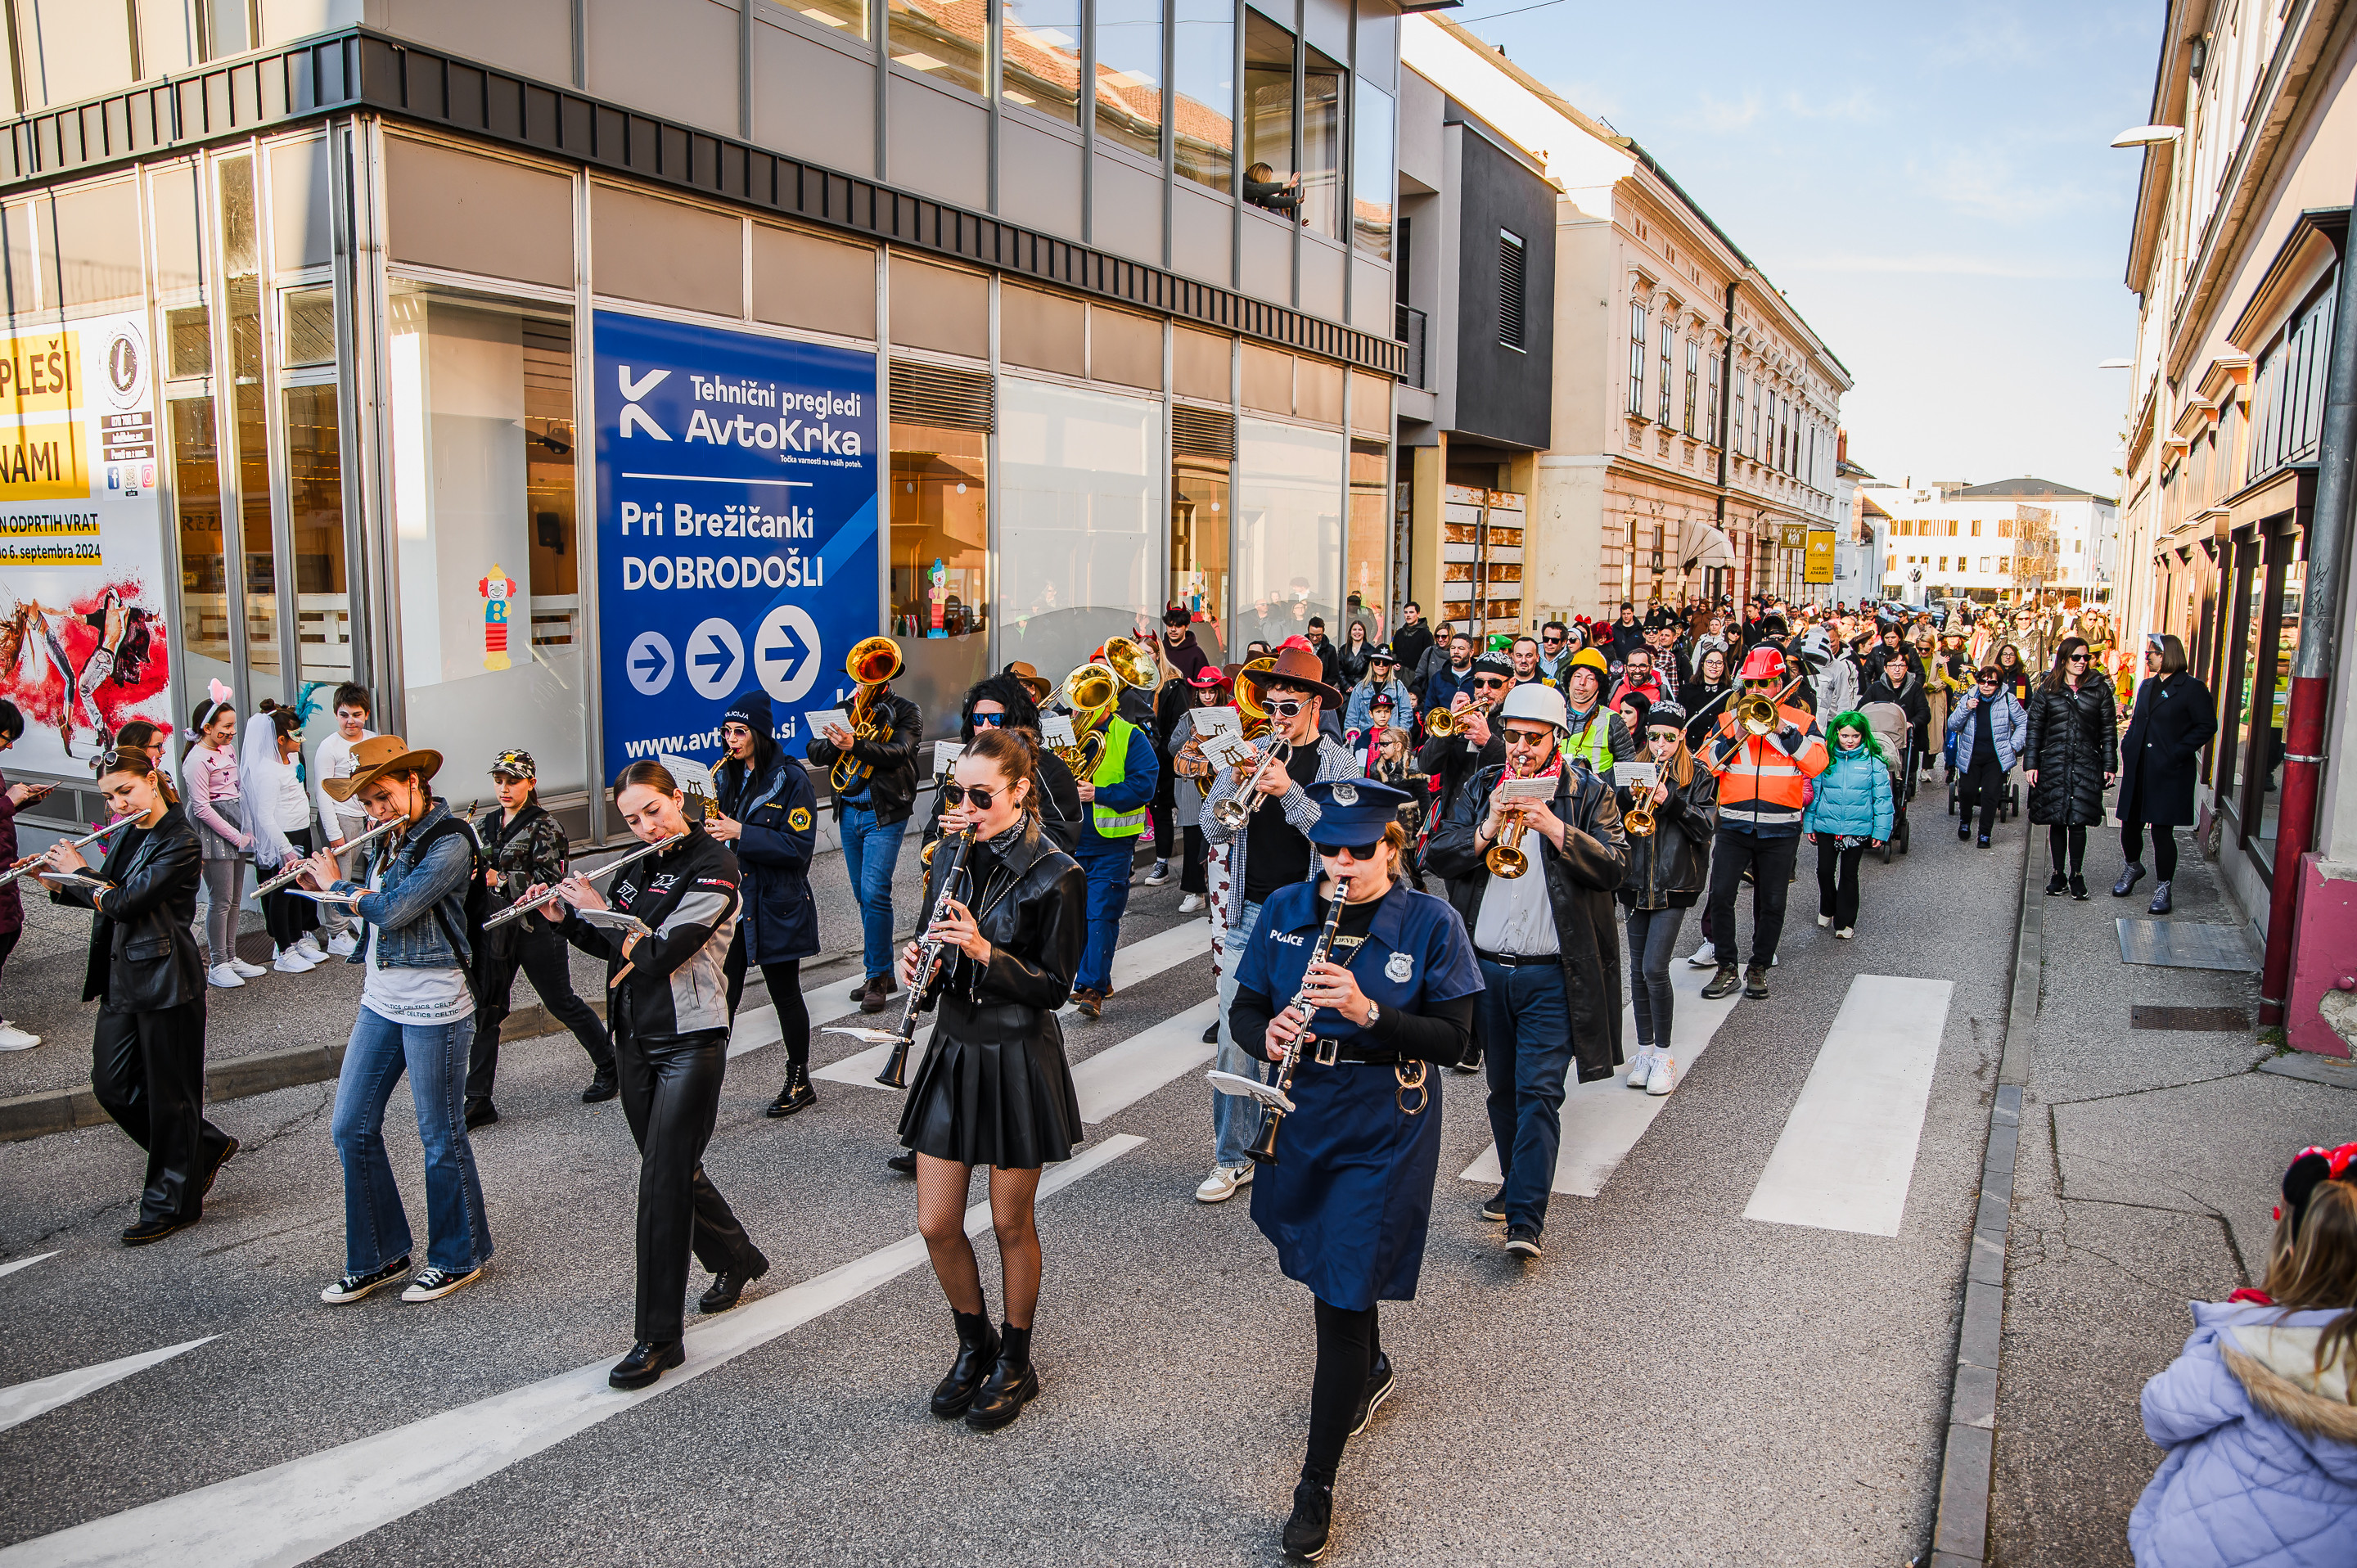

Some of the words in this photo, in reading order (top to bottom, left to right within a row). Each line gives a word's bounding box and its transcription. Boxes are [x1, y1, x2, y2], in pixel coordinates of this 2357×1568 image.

[0, 340, 73, 398] PLEŠI
[690, 375, 775, 408] Tehnični
[782, 390, 861, 420] pregledi
[684, 409, 862, 456] AvtoKrka
[0, 442, 61, 484] NAMI
[780, 454, 797, 463] Točka
[798, 457, 822, 466] varnosti
[830, 458, 845, 467] vaših
[845, 460, 863, 469] poteh.
[9, 514, 63, 533] ODPRTIH
[64, 512, 98, 532] VRAT
[621, 501, 663, 536] Pri
[674, 504, 813, 538] Brežičanki
[9, 544, 18, 560] 6.
[20, 543, 74, 563] septembra
[75, 543, 101, 559] 2024
[623, 547, 823, 590] DOBRODOŠLI
[1270, 929, 1304, 946] POLICE
[434, 998, 459, 1009] CELTIC
[435, 1008, 461, 1018] CELTIC
